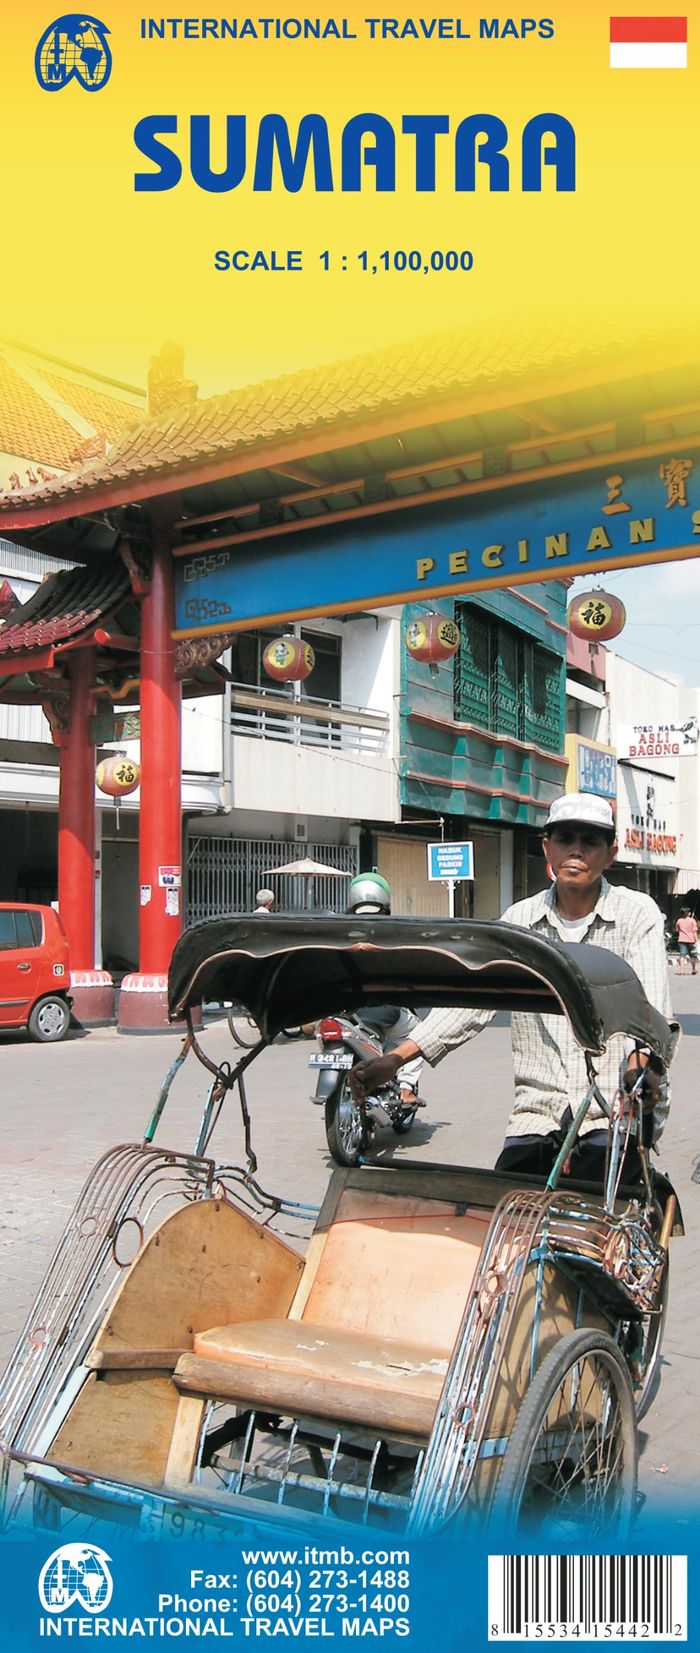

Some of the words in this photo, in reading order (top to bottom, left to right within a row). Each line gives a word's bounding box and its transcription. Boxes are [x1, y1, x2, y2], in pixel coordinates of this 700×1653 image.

[416, 518, 655, 580] PECINAN
[639, 732, 669, 744] ASLI
[629, 743, 679, 757] BAGONG
